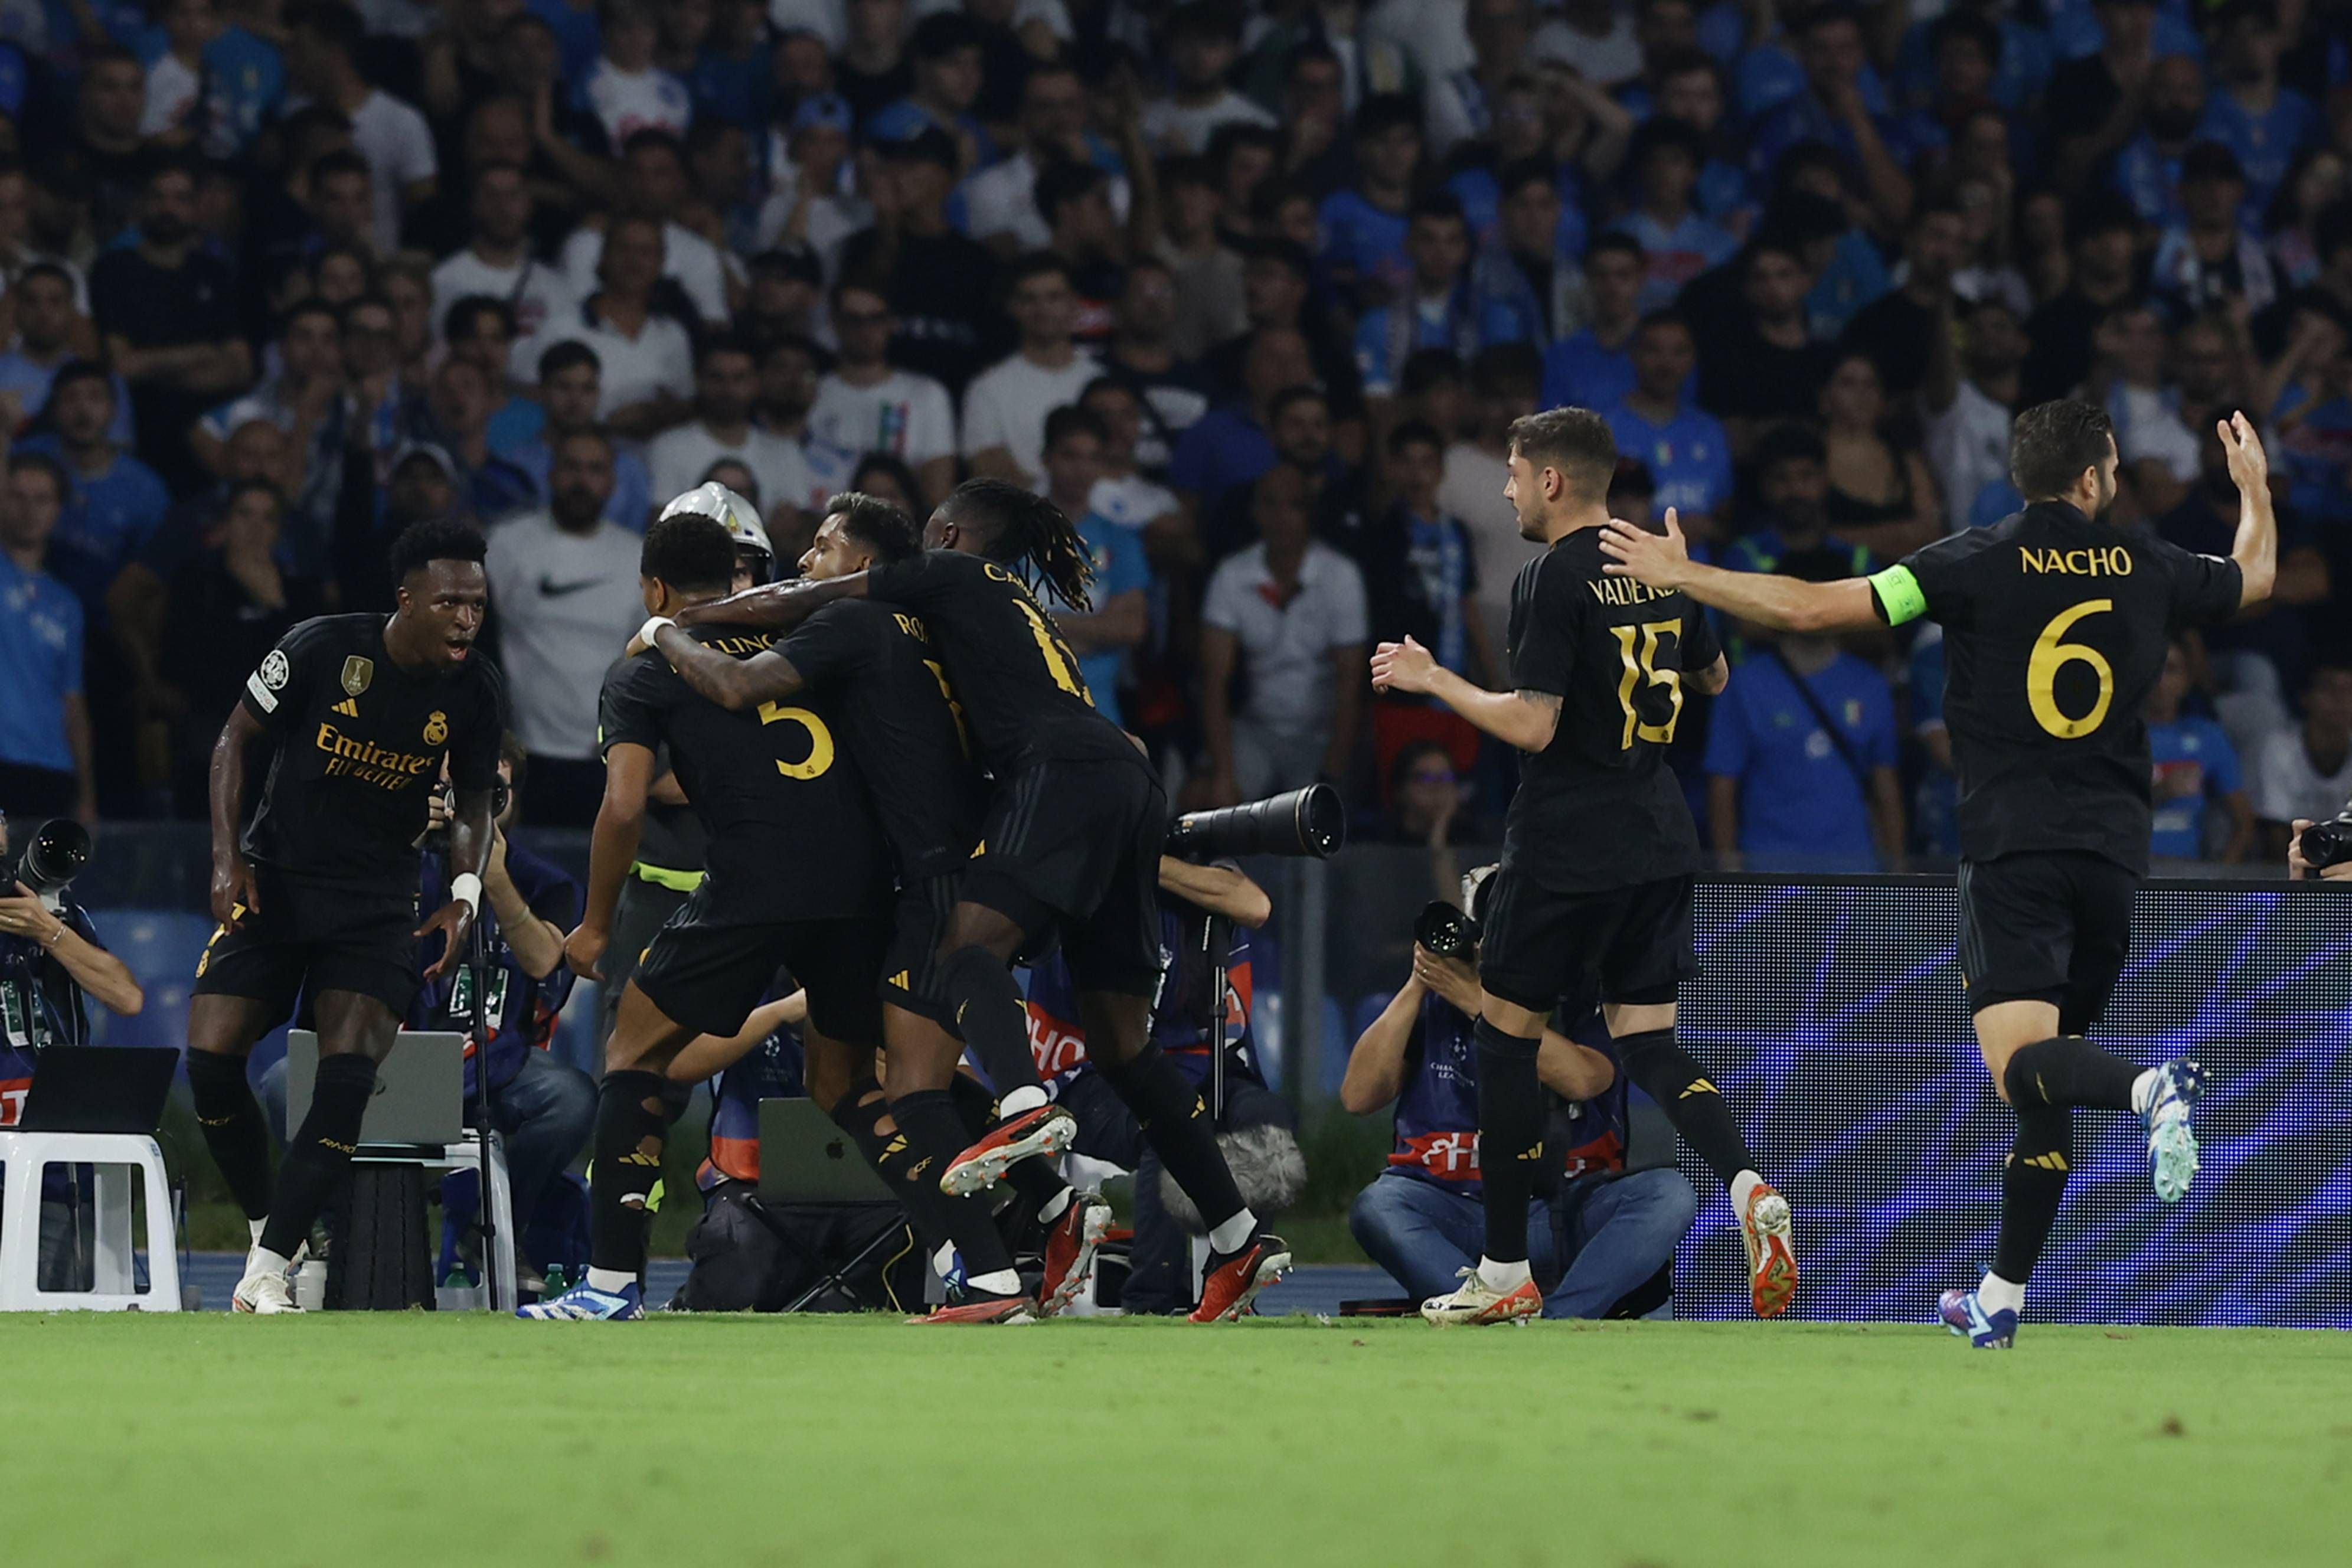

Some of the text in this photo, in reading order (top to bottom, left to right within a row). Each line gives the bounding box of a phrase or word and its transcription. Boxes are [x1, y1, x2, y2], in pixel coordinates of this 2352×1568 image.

[2018, 545, 2134, 577] NACHO
[1608, 616, 1685, 752] 15
[2027, 597, 2115, 740] 6
[756, 699, 835, 781] 5
